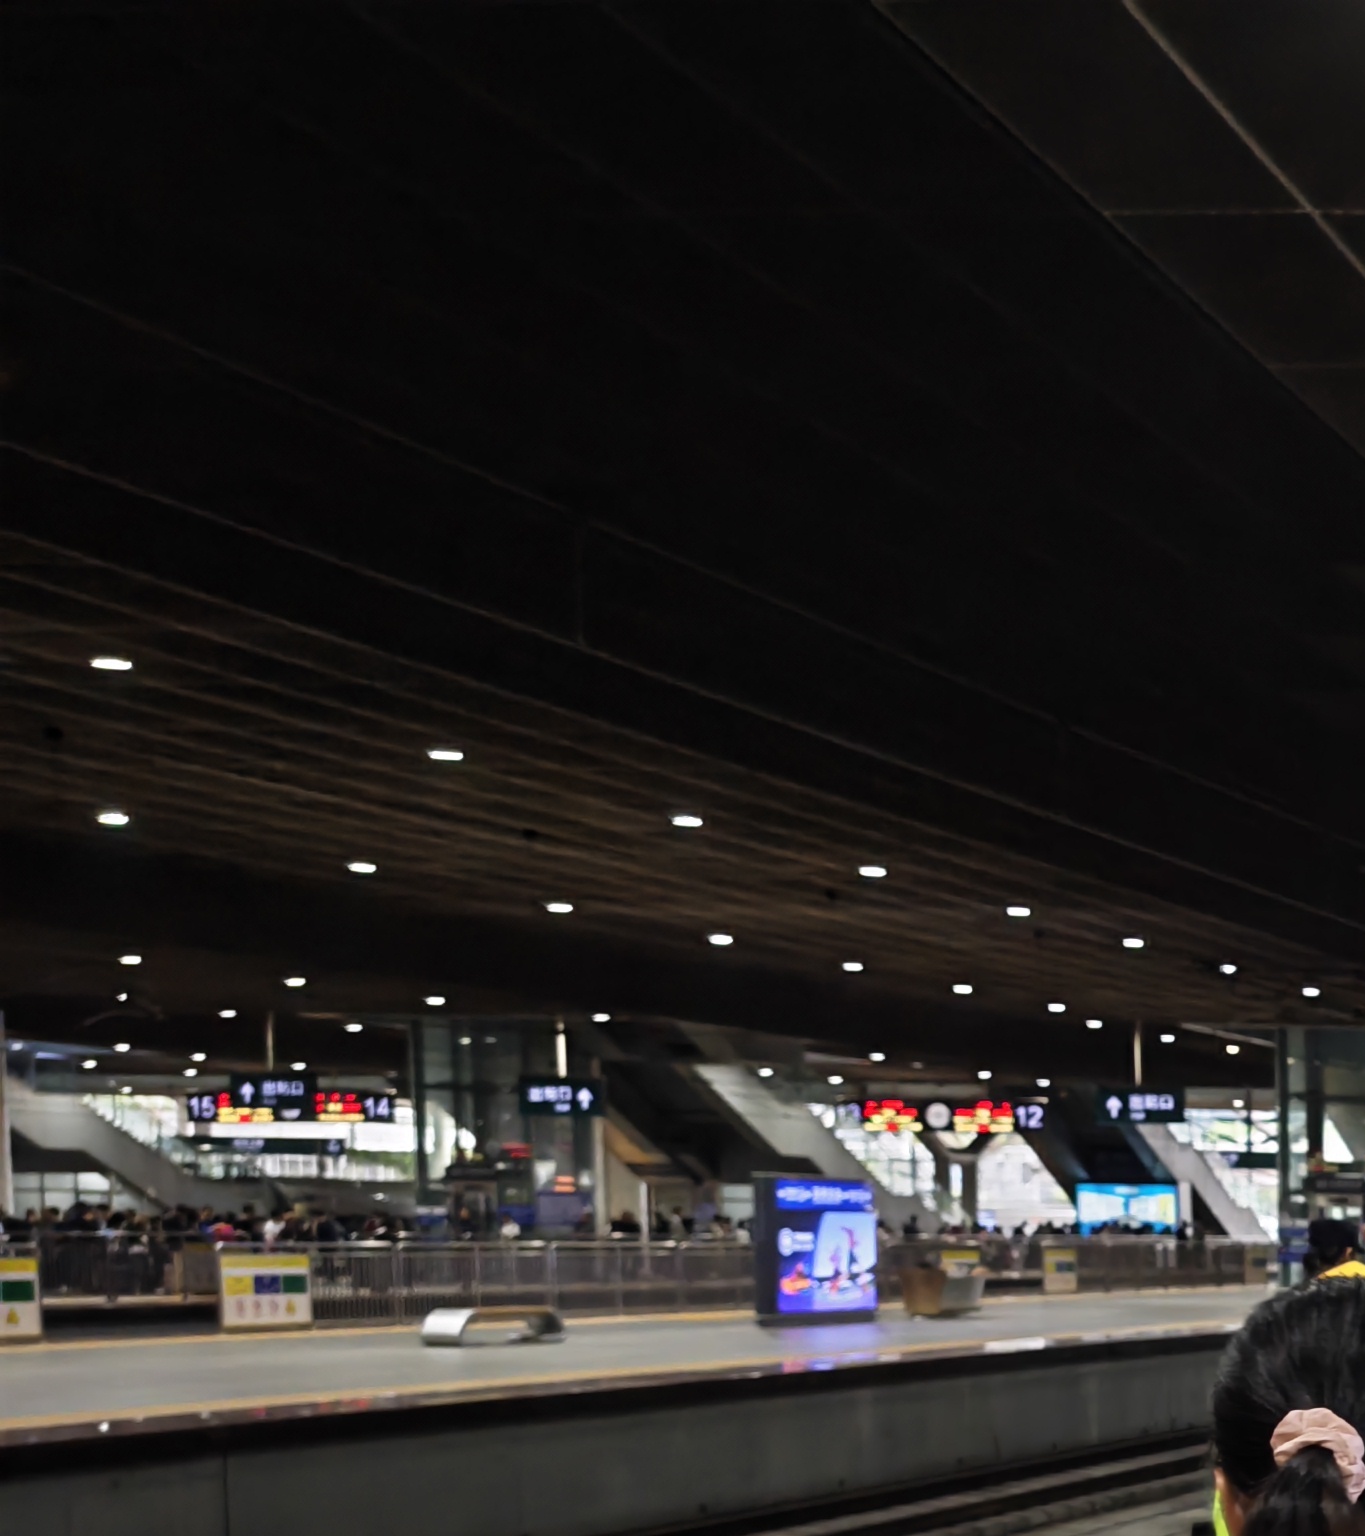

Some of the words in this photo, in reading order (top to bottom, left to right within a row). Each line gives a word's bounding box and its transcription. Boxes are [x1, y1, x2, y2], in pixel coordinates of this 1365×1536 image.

[189, 1096, 215, 1120] 15
[364, 1096, 390, 1119] 14
[1015, 1105, 1043, 1129] 12
